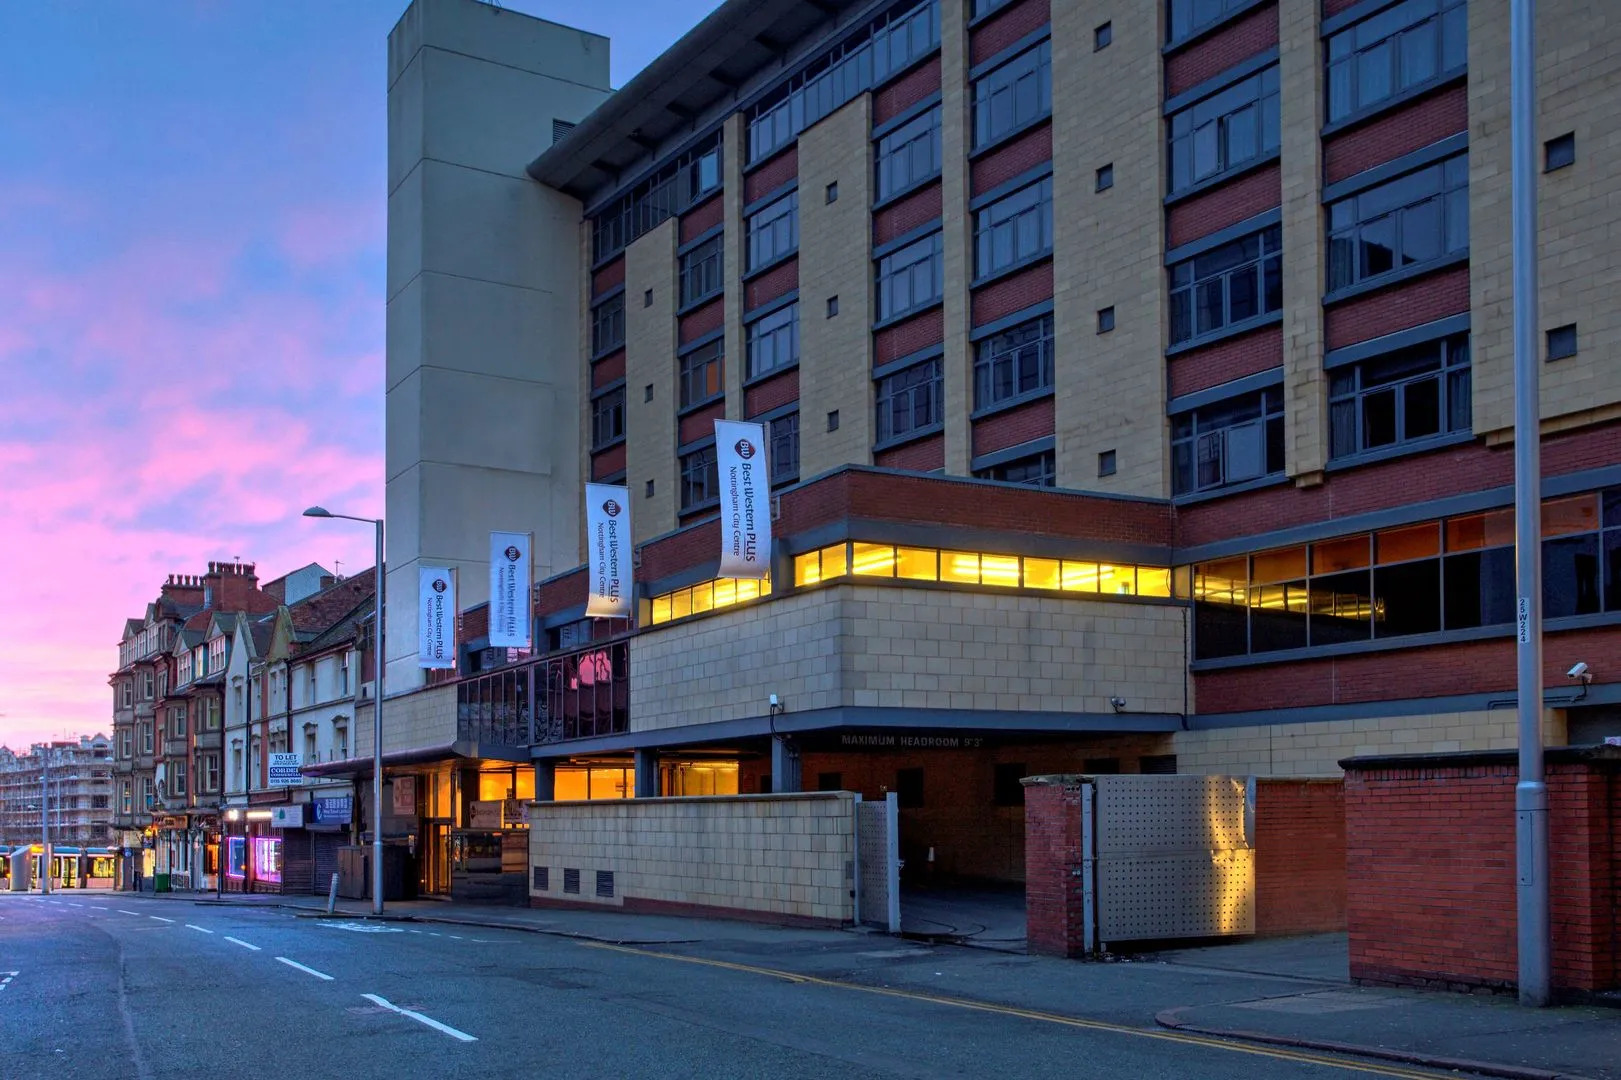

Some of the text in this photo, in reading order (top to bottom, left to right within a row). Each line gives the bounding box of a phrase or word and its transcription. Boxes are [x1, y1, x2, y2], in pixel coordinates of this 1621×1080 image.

[740, 441, 750, 458] BW
[730, 466, 741, 556] Nottingham City Centre
[742, 463, 756, 562] Best Western PLUS
[597, 522, 606, 560] Nottingham
[508, 565, 516, 580] Best
[608, 520, 620, 603] Best Western PLUS
[507, 583, 516, 614] Western
[436, 641, 444, 659] PLUS
[842, 736, 895, 745] MAXIMUM
[901, 736, 959, 747] HEADROOM
